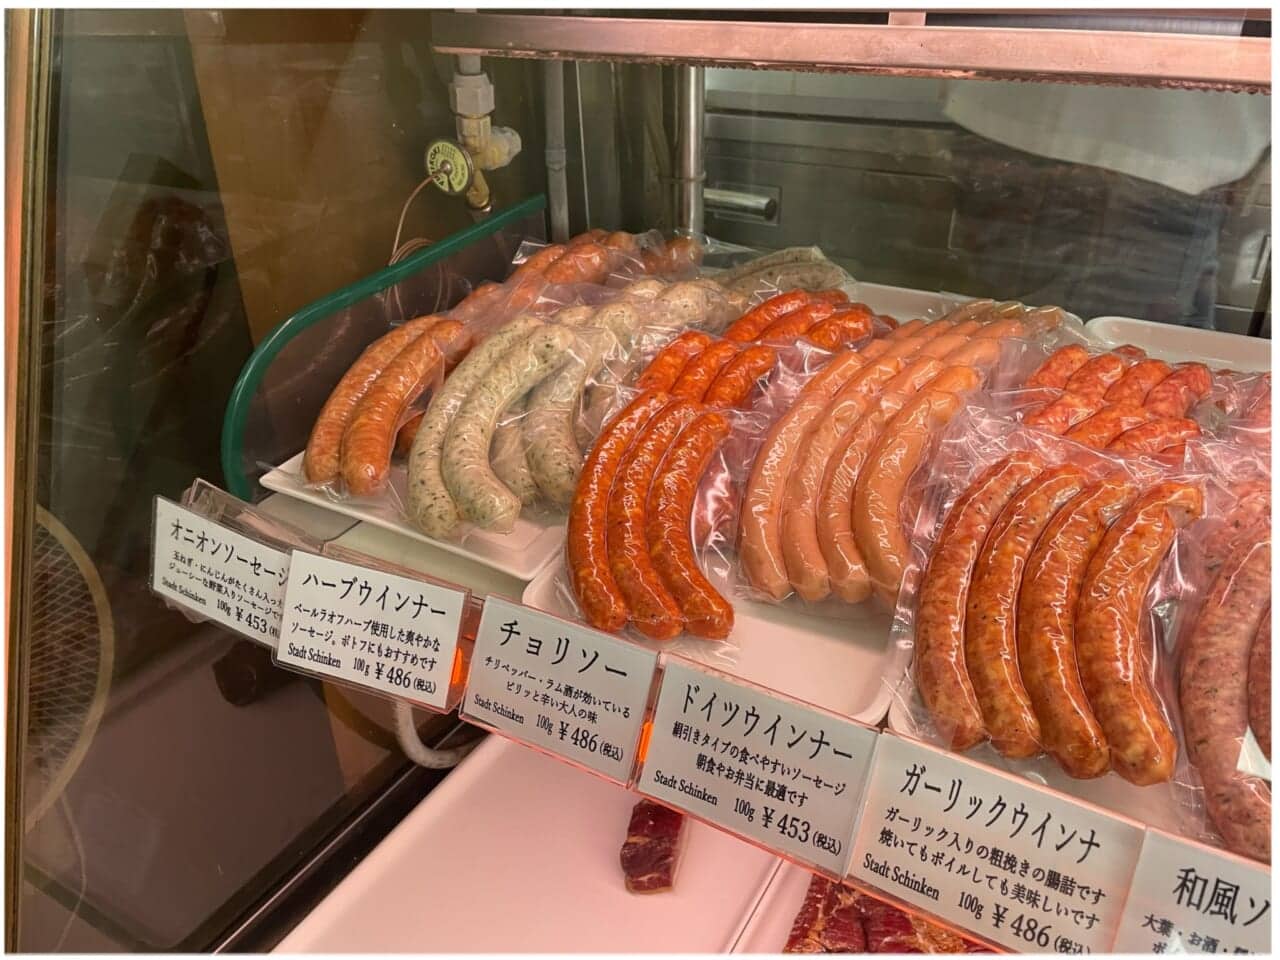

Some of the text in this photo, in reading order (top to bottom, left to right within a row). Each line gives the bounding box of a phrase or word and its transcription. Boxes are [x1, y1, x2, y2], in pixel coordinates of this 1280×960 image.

[170, 518, 289, 587] オニオンソーセージ
[217, 599, 232, 617] 100g
[302, 572, 447, 619] ハーブウインナー
[287, 642, 308, 660] Stadt
[307, 647, 342, 669] Schinken
[353, 656, 370, 677] 100g
[500, 620, 628, 678] チョリソー
[474, 693, 493, 712] Stadt
[491, 701, 525, 725] Schinken
[536, 713, 554, 735] 100g
[682, 683, 853, 760] ドイツウインナー
[653, 769, 679, 791] Stadt
[678, 778, 718, 807] Schinken
[734, 797, 756, 823] 100g
[696, 752, 809, 808] 朝食やお弁当に最適です
[899, 763, 1101, 865] ガーリックウインナ
[863, 852, 890, 880] Stadt
[891, 865, 940, 902] Schinken
[957, 891, 985, 920] 100g
